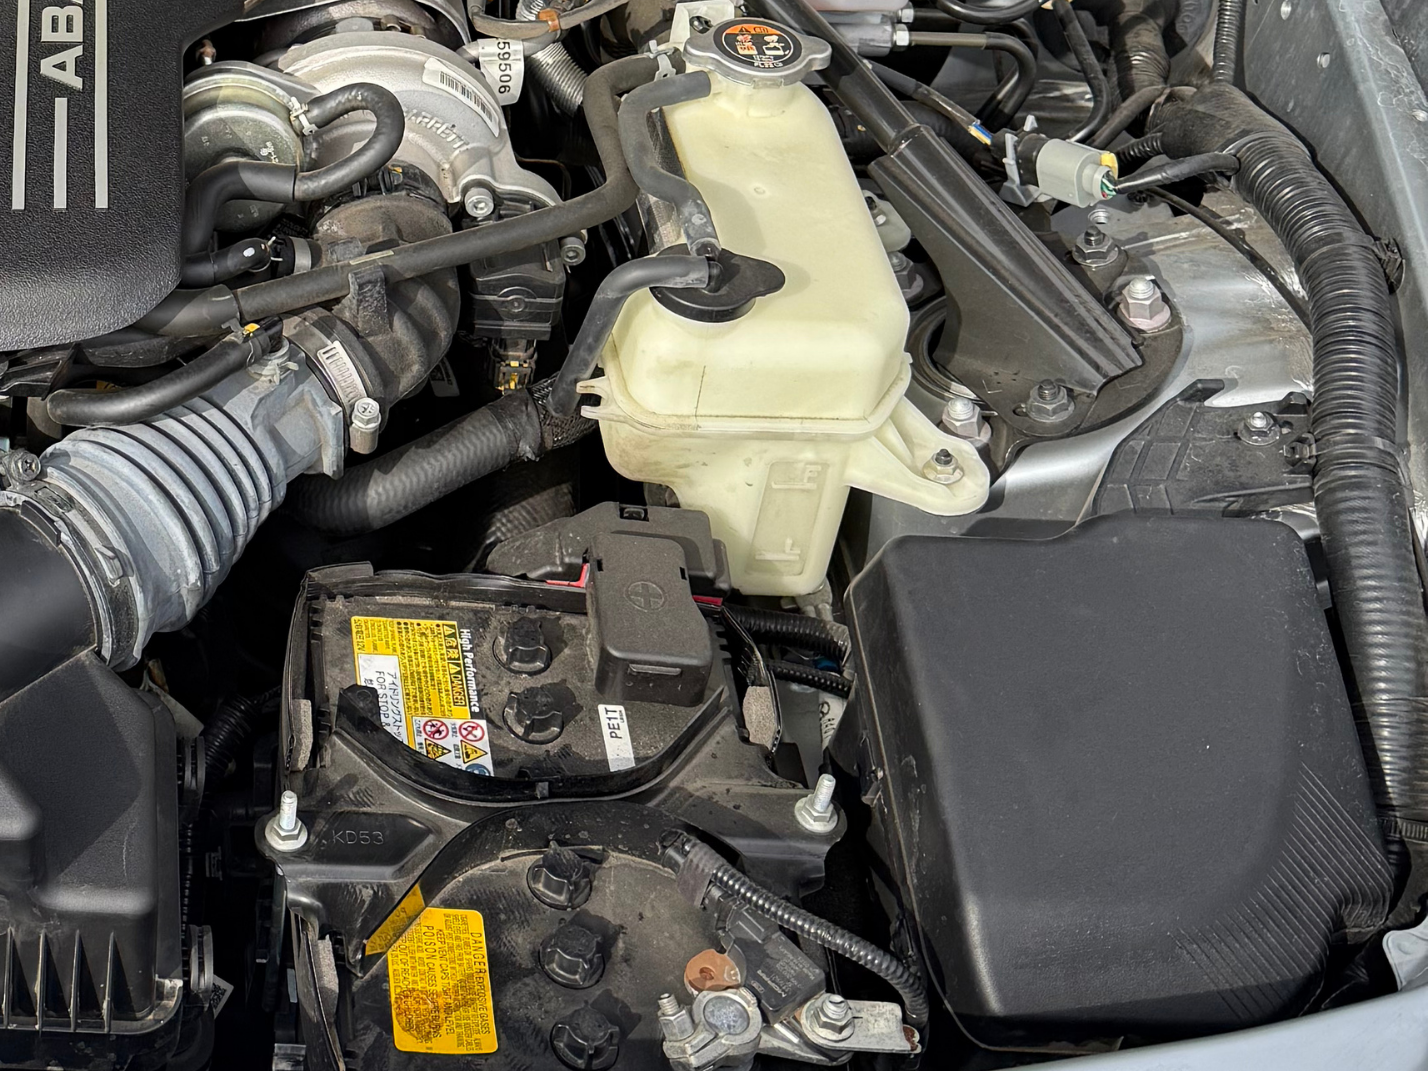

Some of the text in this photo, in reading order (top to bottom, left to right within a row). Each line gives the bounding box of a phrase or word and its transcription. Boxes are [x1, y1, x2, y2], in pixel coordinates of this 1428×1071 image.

[375, 670, 387, 694] FOR
[459, 628, 480, 713] High Performance
[450, 675, 466, 706] DANGER
[378, 694, 389, 720] STOP
[608, 706, 623, 741] PE1T
[332, 830, 384, 845] KD53
[398, 945, 407, 955] OUT
[423, 925, 436, 959] POISON
[400, 968, 410, 989] REACH
[426, 962, 437, 987] CAUSES
[439, 963, 449, 980] CAPS
[470, 932, 486, 974] DANGER
[479, 1012, 490, 1034] GASES
